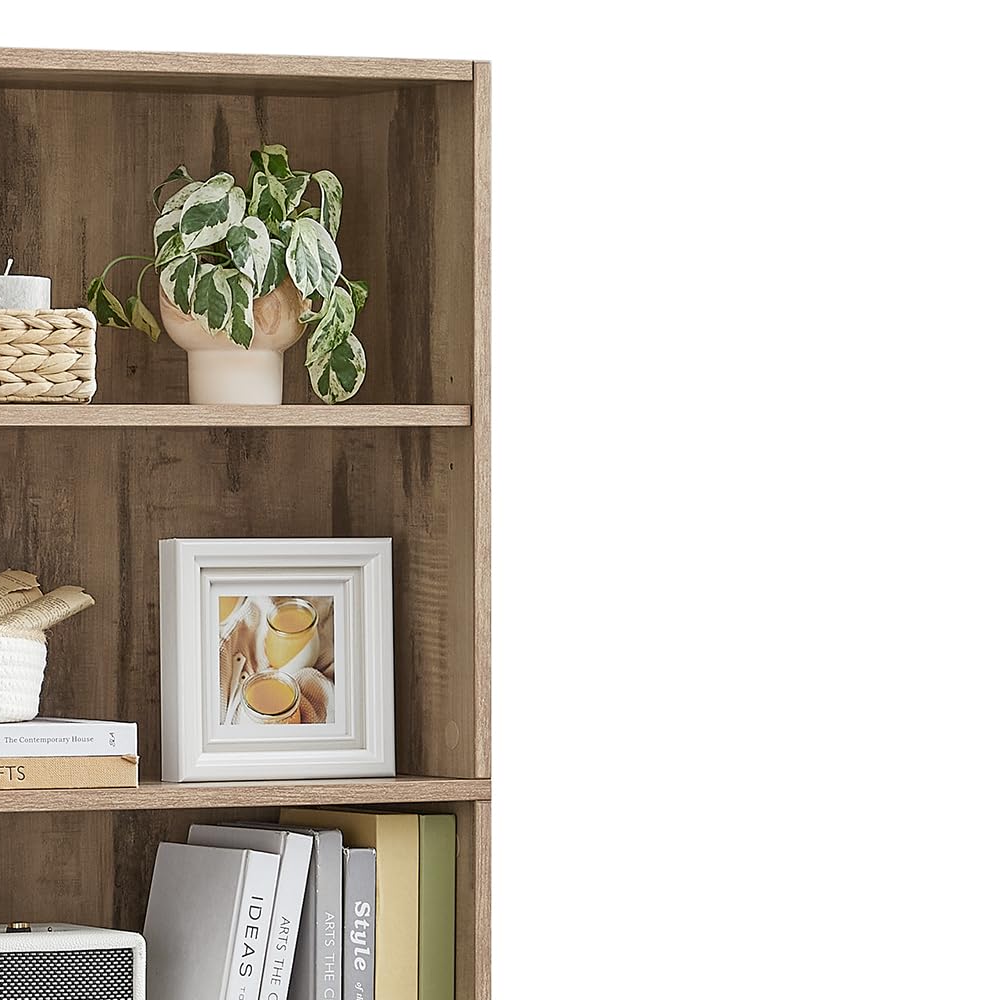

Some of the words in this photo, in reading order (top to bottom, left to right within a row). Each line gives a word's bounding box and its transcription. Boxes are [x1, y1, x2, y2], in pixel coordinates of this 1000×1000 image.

[4, 736, 17, 744] The
[18, 736, 71, 745] Contemporary
[239, 896, 264, 977] IDEAS
[276, 916, 291, 951] ARTS
[324, 912, 335, 947] ARTS
[350, 900, 371, 971] Style
[270, 958, 285, 985] THE
[324, 953, 335, 981] THE
[354, 982, 364, 993] of
